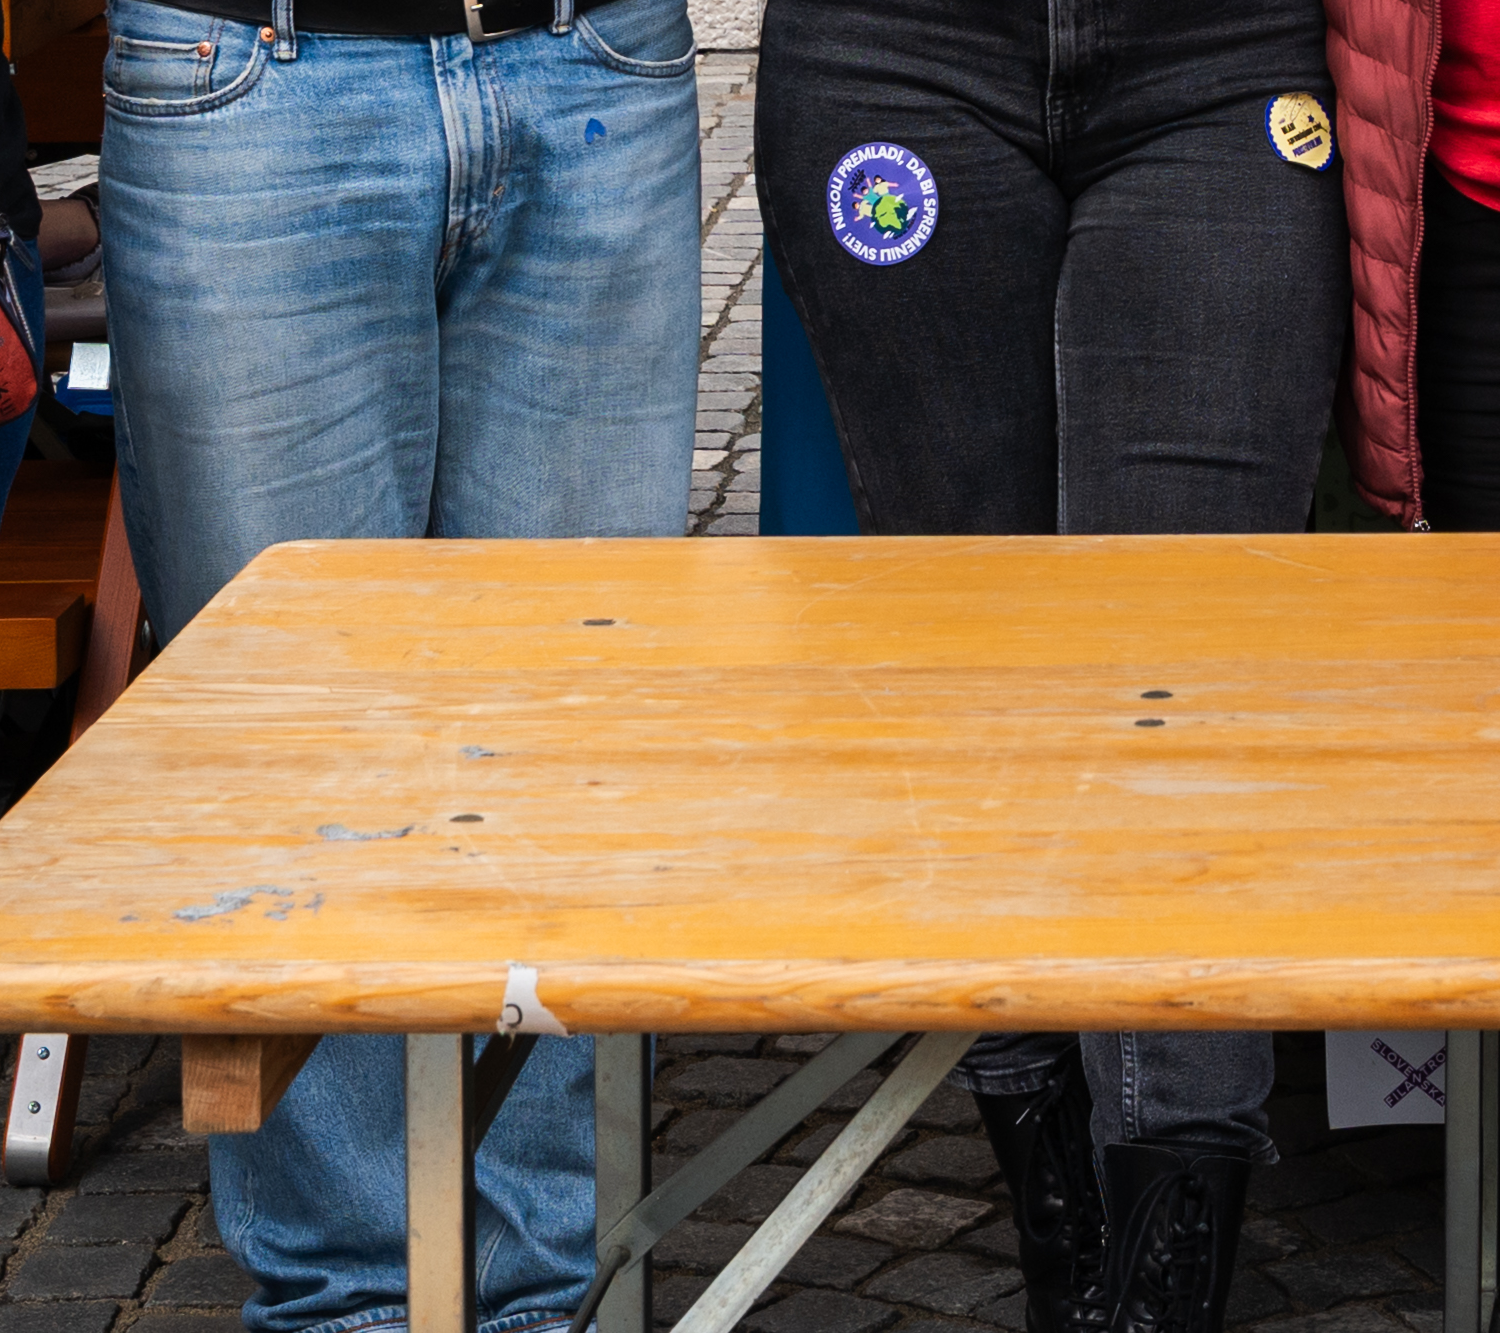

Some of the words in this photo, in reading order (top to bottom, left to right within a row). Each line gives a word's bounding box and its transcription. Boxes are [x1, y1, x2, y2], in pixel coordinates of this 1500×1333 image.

[837, 145, 904, 178] PREMLADI,
[905, 157, 927, 181] DA
[920, 178, 935, 195] BI
[830, 176, 846, 231] NIKOLI
[842, 232, 877, 261] SVET!
[881, 198, 936, 262] SPREMENILI
[1384, 1045, 1446, 1107] FILANTRO
